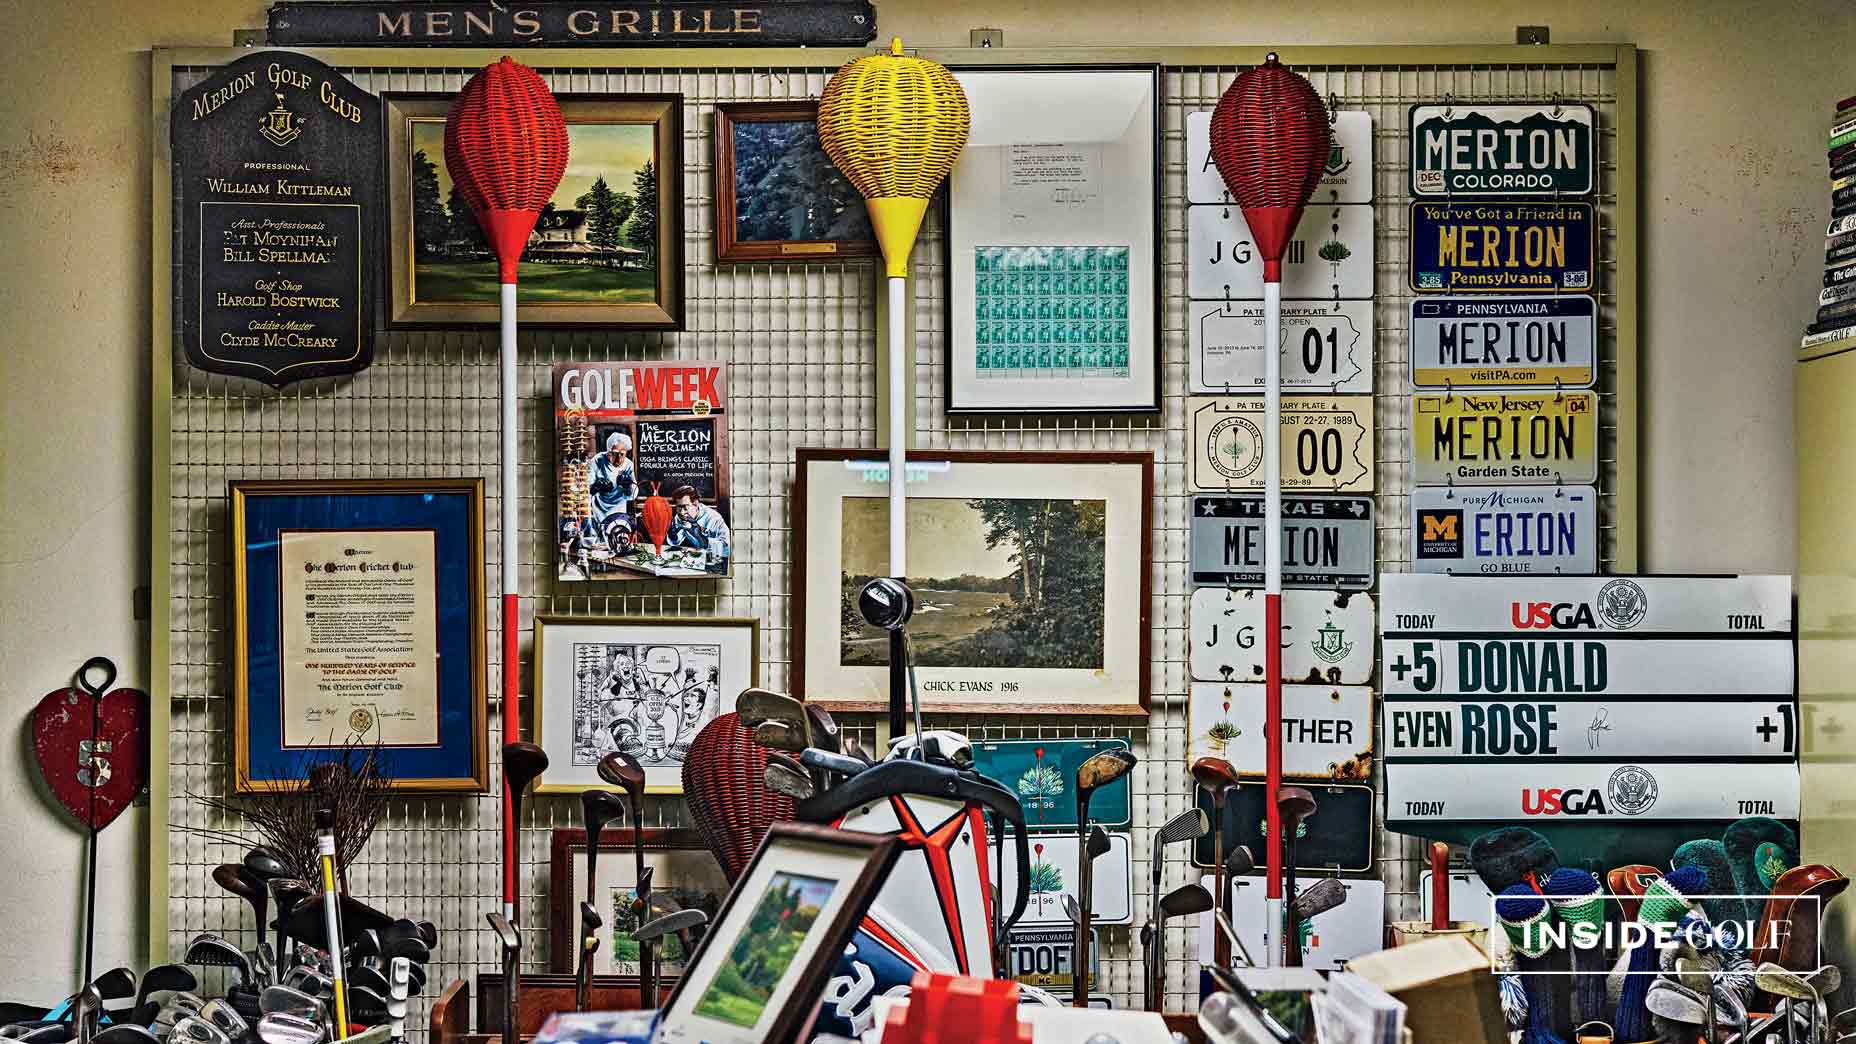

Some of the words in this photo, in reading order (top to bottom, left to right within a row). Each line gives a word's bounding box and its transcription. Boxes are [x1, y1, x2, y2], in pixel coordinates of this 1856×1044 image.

[567, 9, 761, 35] GRILLE
[192, 71, 256, 121] MERION
[267, 62, 312, 91] GOLF
[320, 80, 361, 124] CLUB
[1424, 129, 1577, 170] MERION
[244, 162, 311, 171] PROFESSIONAL
[1421, 172, 1441, 182] DEC
[1452, 174, 1553, 188] COLORADO
[207, 178, 270, 194] WILLIAM
[276, 179, 352, 197] KITTLEMAN
[1475, 207, 1500, 220] Got
[1505, 210, 1513, 220] a
[1517, 207, 1565, 220] Friend
[1568, 208, 1583, 220] in
[258, 218, 326, 231] Professionals
[1209, 240, 1222, 265] J
[1232, 240, 1251, 265] G
[1438, 225, 1565, 267] MERION
[223, 247, 255, 262] BILL
[255, 279, 276, 291] Golf
[278, 279, 303, 292] Shop
[1450, 271, 1553, 286] Pennsylvania
[216, 292, 266, 307] HAROLD
[270, 292, 341, 308] BOSTWICK
[1302, 308, 1328, 316] PLATE
[1457, 303, 1549, 315] PENNSYLVANIA
[248, 319, 280, 331] Caddie
[220, 332, 260, 347] CLYDE
[1438, 321, 1567, 364] MERION
[1302, 327, 1338, 374] 01
[1470, 370, 1537, 381] visitPA.com
[1463, 397, 1498, 412] New
[1498, 396, 1545, 414] Jersey
[640, 422, 660, 431] The
[1333, 415, 1353, 425] 1989
[640, 429, 711, 444] MERION
[1433, 415, 1575, 461] MERION
[639, 442, 711, 453] EXPERIMENT
[1297, 428, 1343, 476] 00
[1457, 465, 1507, 478] Garden
[1511, 465, 1550, 478] State
[1475, 512, 1575, 556] ERION
[1224, 525, 1339, 567] MEION
[1480, 563, 1498, 573] GO
[1501, 563, 1531, 573] BLUE
[1396, 614, 1435, 629] TODAY
[1512, 602, 1598, 629] USGA
[1727, 615, 1765, 630] TOTAL
[1206, 624, 1218, 648] J
[1236, 626, 1256, 649] G
[1389, 641, 1437, 692] +5
[1458, 641, 1608, 693] DONALD
[923, 681, 955, 692] CHICK
[959, 681, 993, 693] EVANS
[1000, 681, 1019, 692] 1916
[1392, 710, 1452, 748] EVEN
[1461, 703, 1558, 755] ROSE
[1755, 704, 1795, 752] +1
[1027, 801, 1037, 809] 18
[1043, 801, 1055, 809] 96
[1405, 801, 1445, 816] TODAY
[1521, 788, 1607, 815] USGA
[1737, 800, 1776, 815] TOTAL
[1043, 897, 1054, 905] 96
[1015, 934, 1073, 942] PENNSYLVANIA
